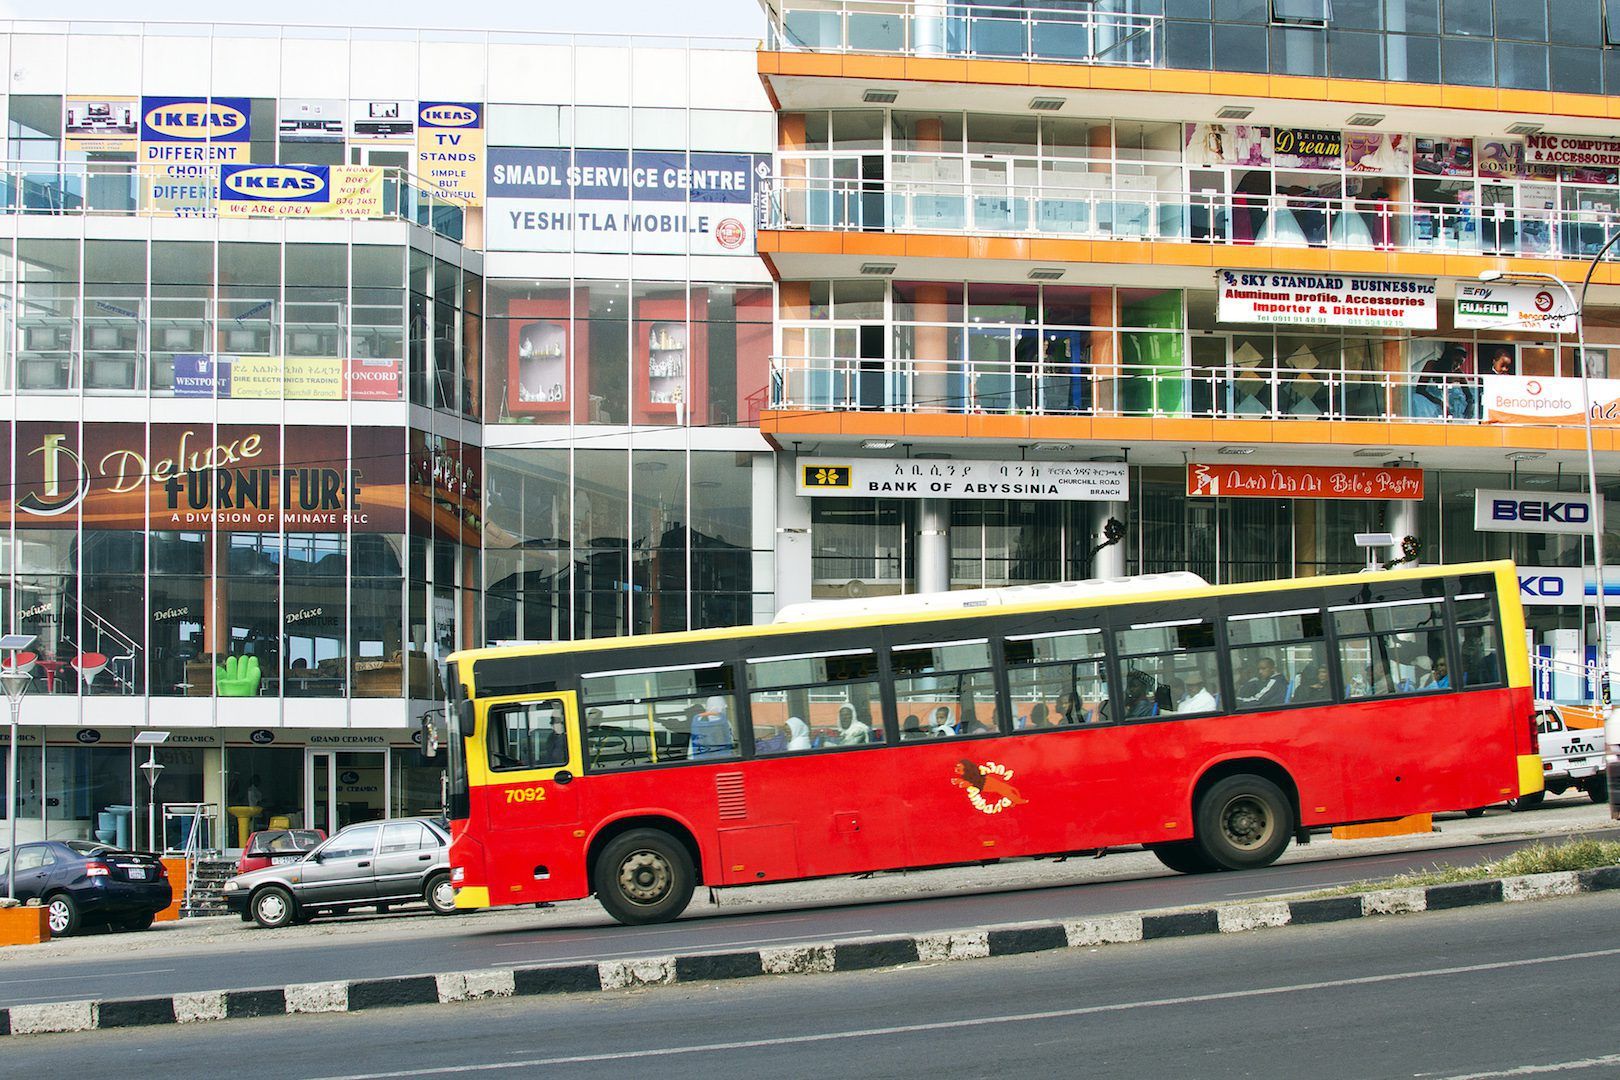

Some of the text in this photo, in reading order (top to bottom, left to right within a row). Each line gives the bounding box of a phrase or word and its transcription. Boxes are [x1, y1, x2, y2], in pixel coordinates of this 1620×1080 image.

[154, 112, 238, 127] IKEAS
[426, 111, 471, 120] IKEAS
[435, 134, 461, 145] TV
[1275, 130, 1340, 155] Dream
[1527, 135, 1557, 149] NIC
[148, 146, 237, 160] DIFFERENT
[420, 152, 476, 161] STANDS
[1534, 151, 1543, 160] &
[431, 169, 467, 177] SIMPLE
[493, 164, 746, 191] SMADL SERVICE CENTRE
[234, 176, 316, 189] IKEAS
[230, 204, 312, 214] WE ARE OPEN
[623, 214, 709, 233] MOBILE
[1241, 274, 1434, 293] SKY STANDARD BUSINESS PLC
[1225, 289, 1290, 300] Aluminum
[1345, 294, 1425, 306] Accessories
[1253, 302, 1311, 314] Importer
[253, 376, 304, 384] ELECTRNICS
[344, 371, 397, 381] CONCORD
[1496, 395, 1572, 411] Benonphoto
[100, 431, 263, 493] Deluxe
[164, 466, 363, 511] FURNITURE
[868, 481, 1059, 494] BANK OF ABYSSINIA
[1375, 471, 1419, 495] Pastry
[1492, 499, 1589, 523] BEKO
[171, 514, 180, 522] A
[186, 514, 251, 523] DIVISION
[257, 514, 275, 523] OF
[284, 514, 336, 524] MINAYE
[1517, 576, 1564, 596] KO
[17, 603, 52, 620] Deluxe
[153, 606, 189, 621] Deluxe
[285, 607, 323, 624] Deluxe
[172, 735, 215, 743] CERAMICS
[310, 735, 384, 743] GRAND CERAMICS
[1561, 743, 1595, 754] TATA
[504, 786, 547, 804] 7092
